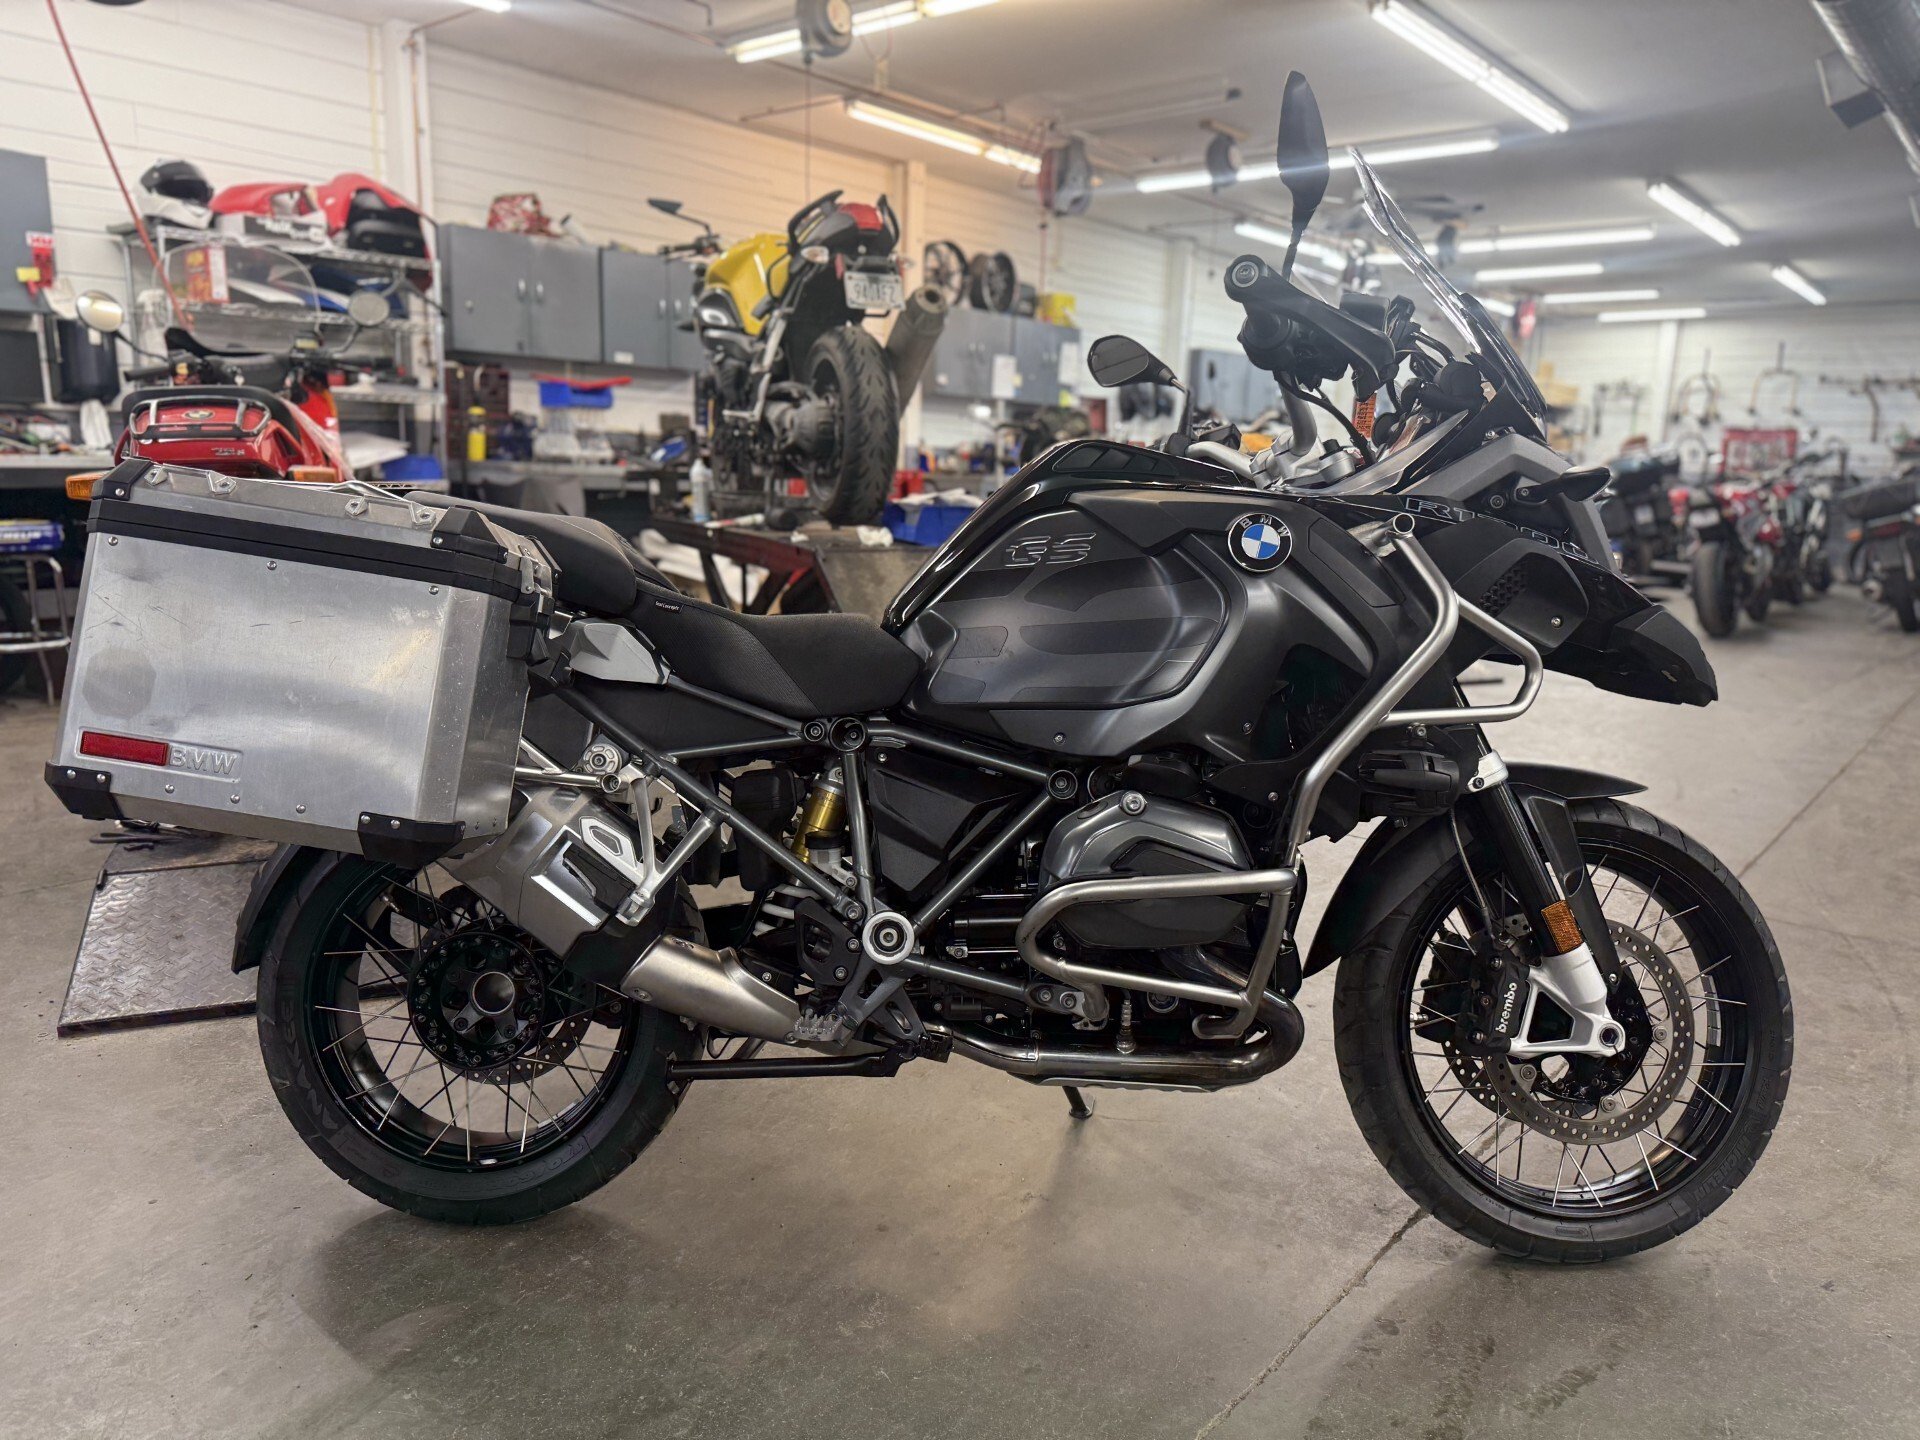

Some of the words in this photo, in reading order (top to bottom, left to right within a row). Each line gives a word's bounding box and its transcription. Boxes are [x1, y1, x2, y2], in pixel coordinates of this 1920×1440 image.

[1239, 514, 1290, 537] BMW
[1004, 532, 1097, 568] GS
[168, 744, 238, 775] BMW
[1495, 982, 1518, 1033] brembo
